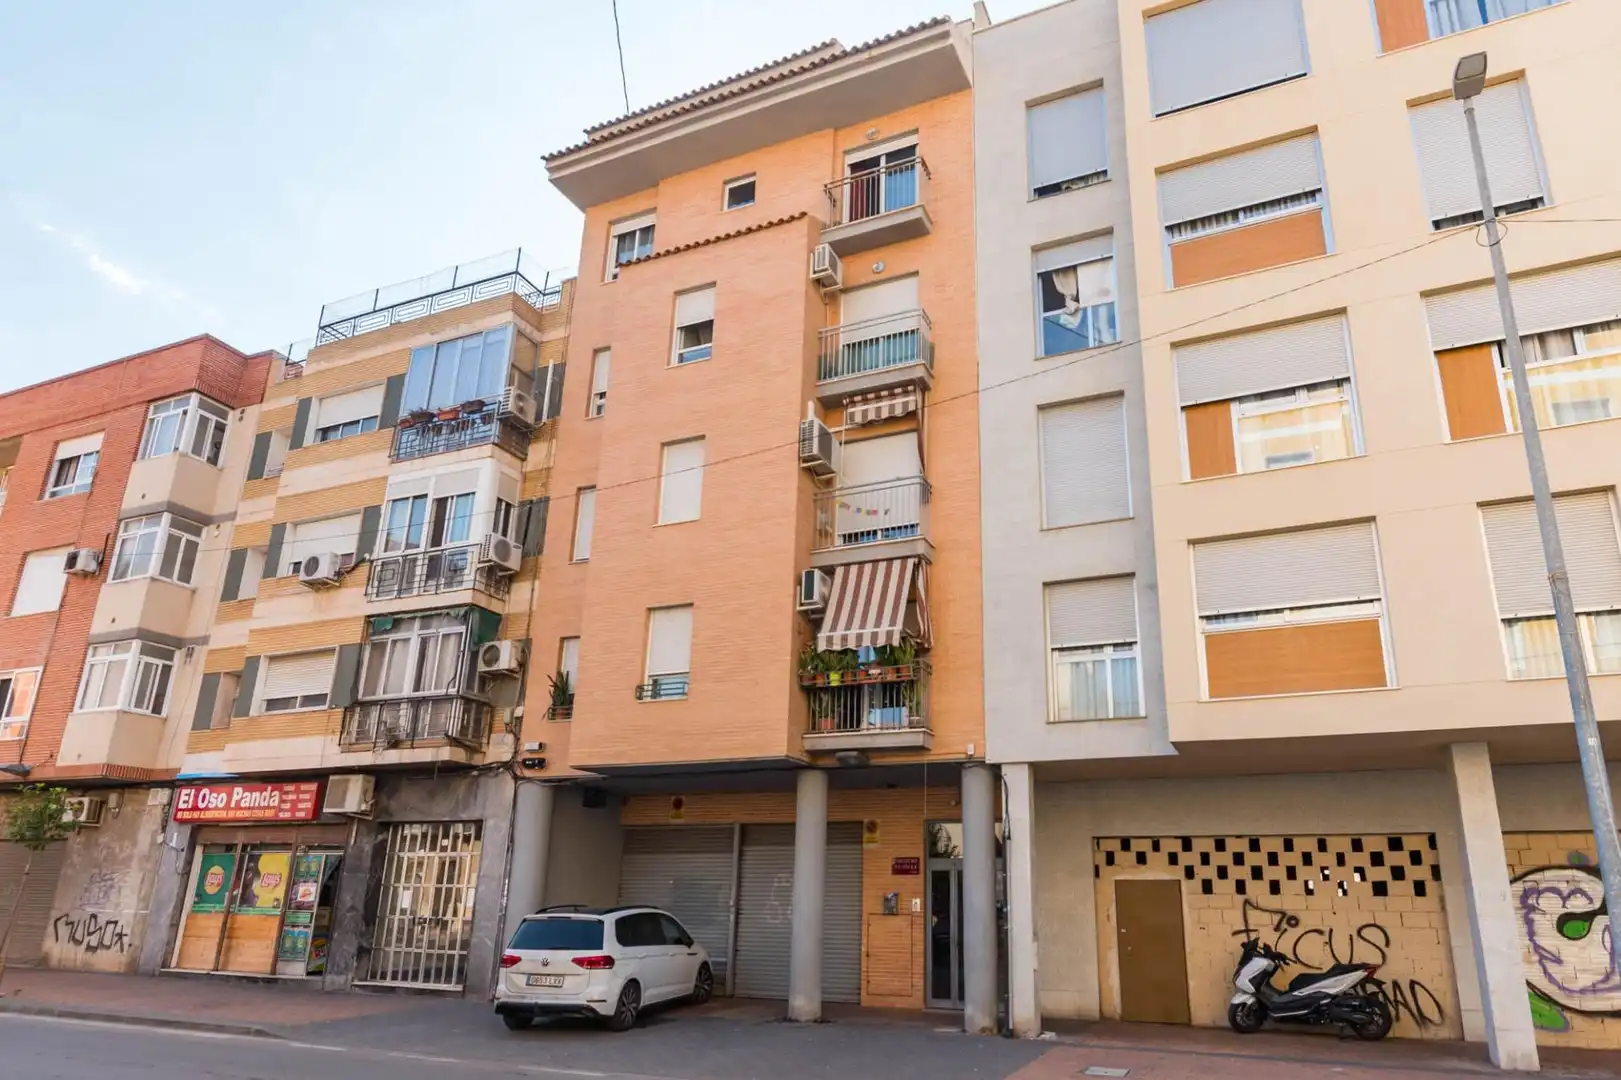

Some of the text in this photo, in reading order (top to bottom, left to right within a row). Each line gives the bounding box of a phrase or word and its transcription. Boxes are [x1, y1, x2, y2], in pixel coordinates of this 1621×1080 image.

[178, 786, 280, 809] El Oso Panda
